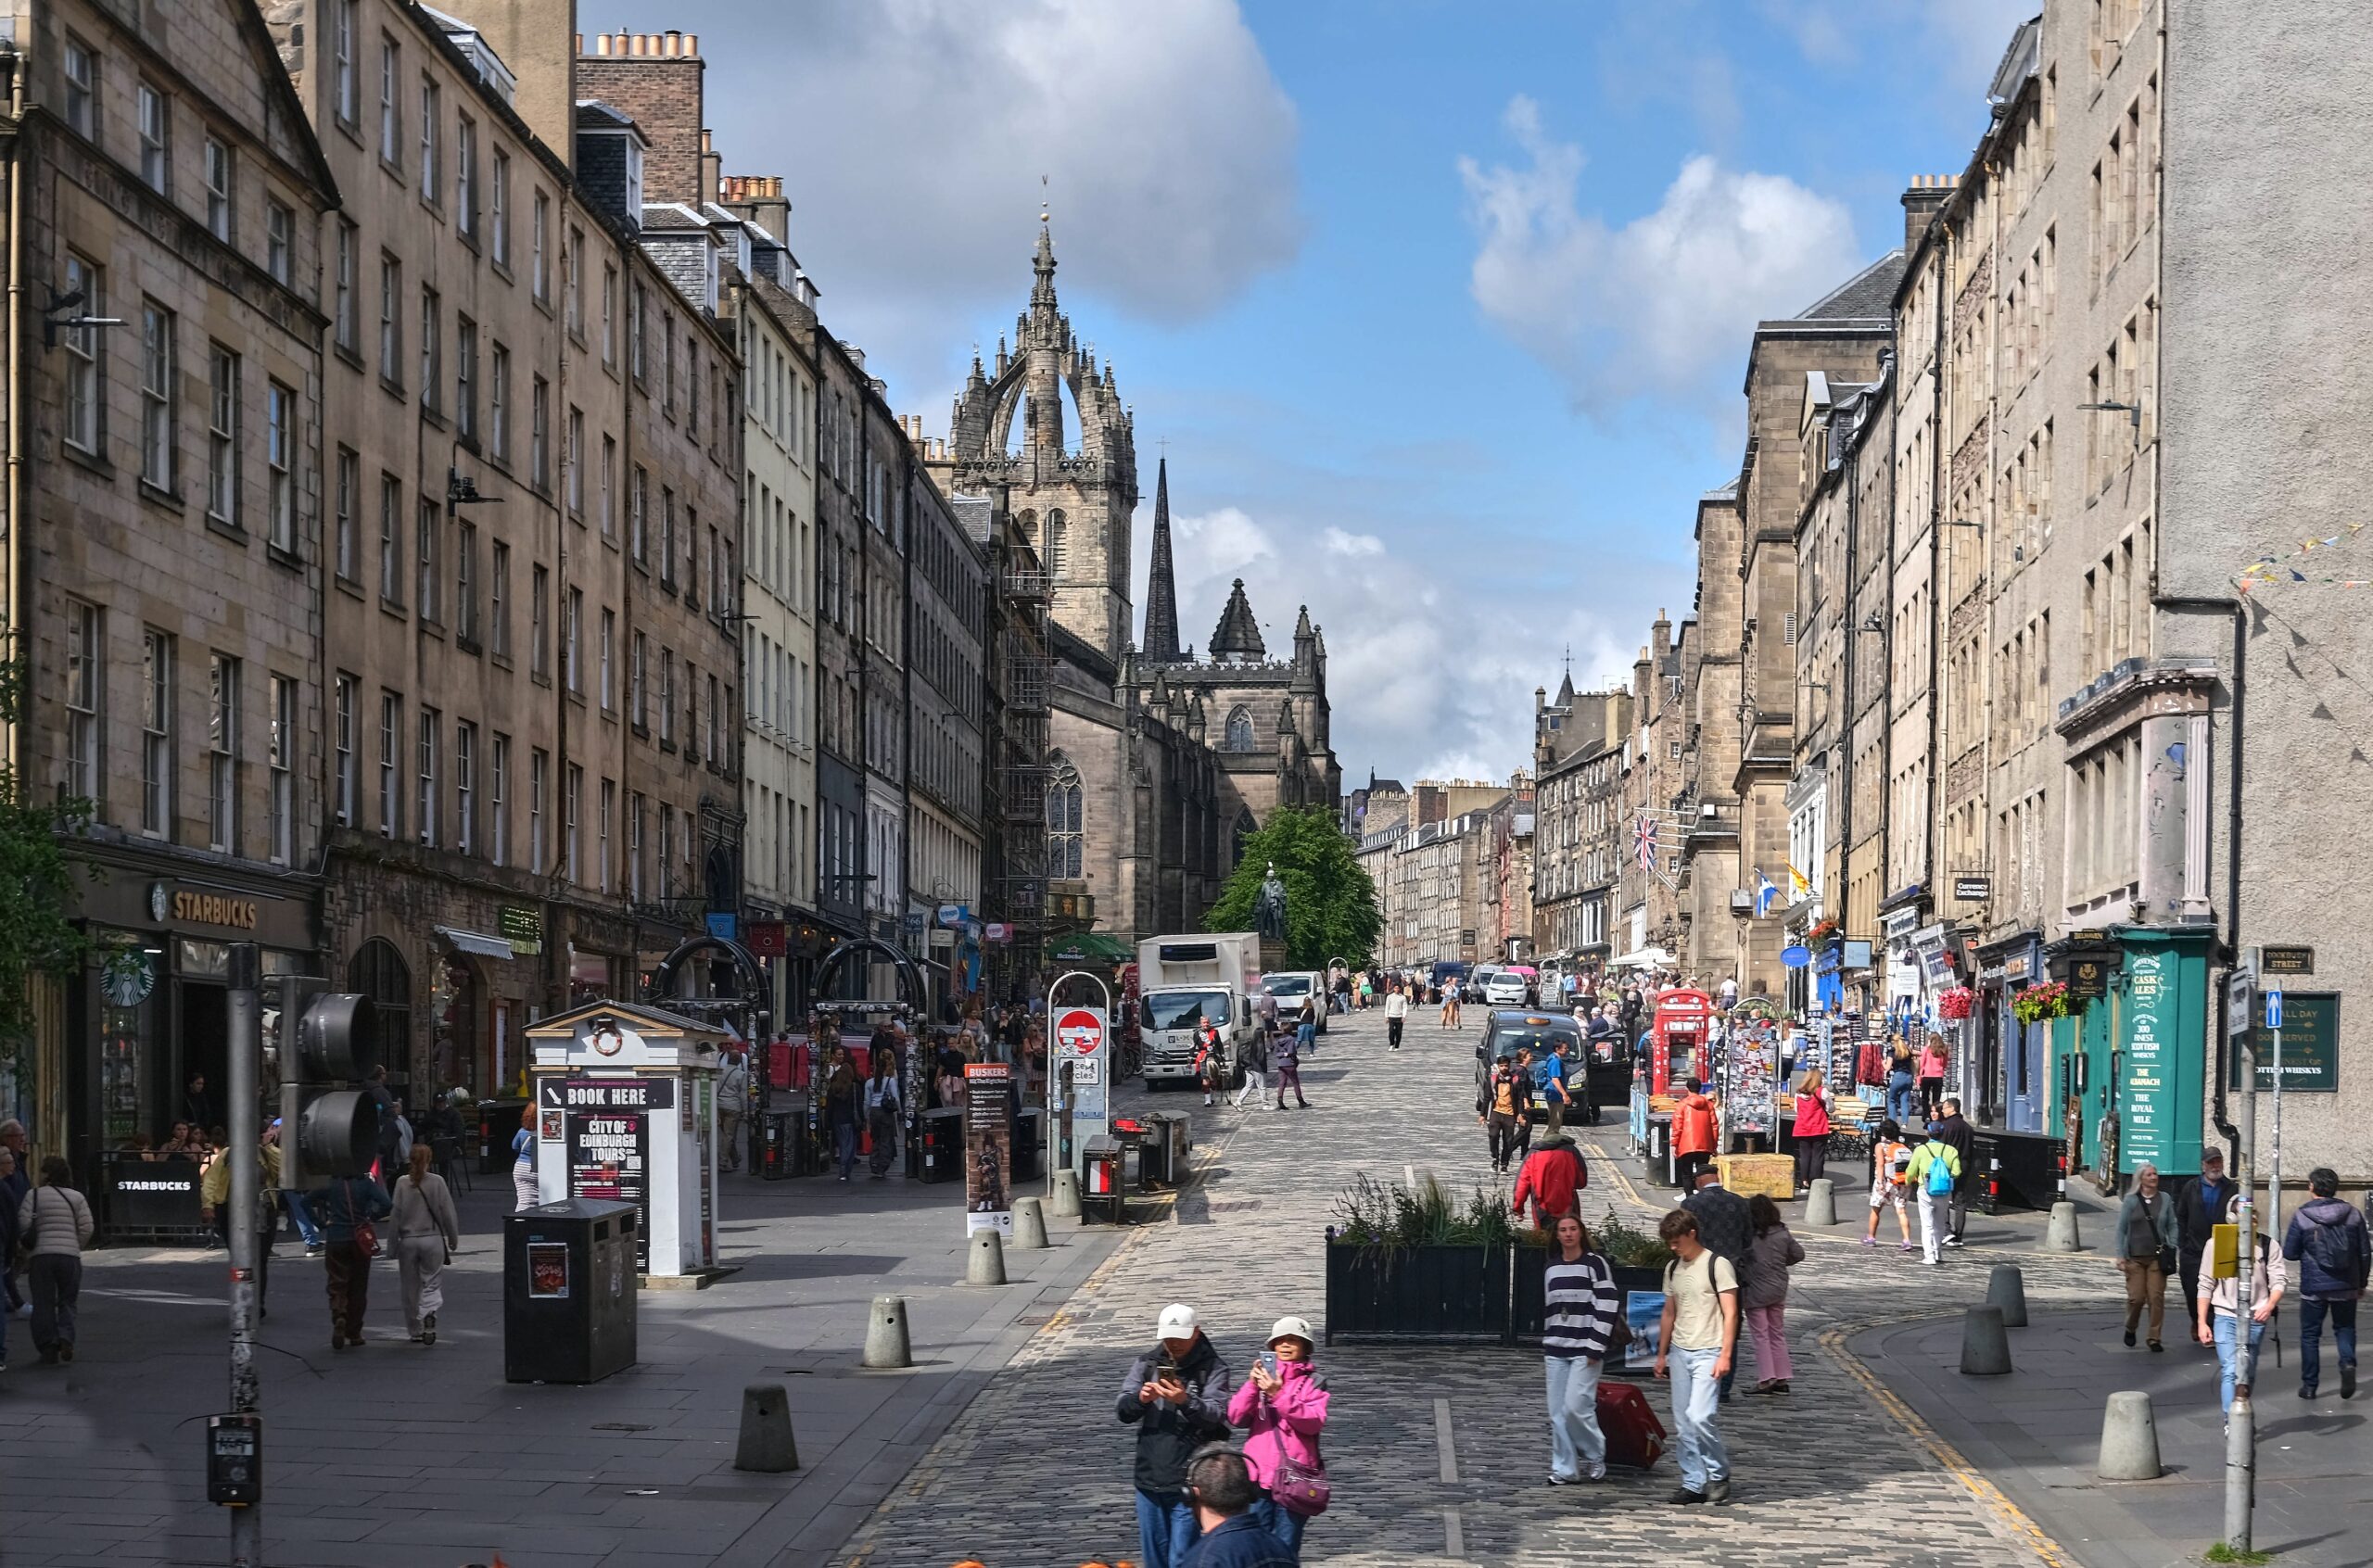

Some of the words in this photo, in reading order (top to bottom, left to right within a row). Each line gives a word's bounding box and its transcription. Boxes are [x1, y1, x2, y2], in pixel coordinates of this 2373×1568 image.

[175, 891, 256, 929] STARBUCKS
[2134, 976, 2157, 984] CASK
[2134, 986, 2156, 994] ALES
[2137, 1025, 2150, 1033] 300
[970, 1068, 1007, 1077] BUSKERS
[568, 1088, 605, 1105] BOOK
[612, 1088, 646, 1105] HERE
[588, 1121, 613, 1134] CITY
[613, 1121, 627, 1134] OF
[580, 1134, 636, 1147] EDINBURGH
[591, 1148, 626, 1161] TOURS
[118, 1181, 191, 1190] STARBUCKS
